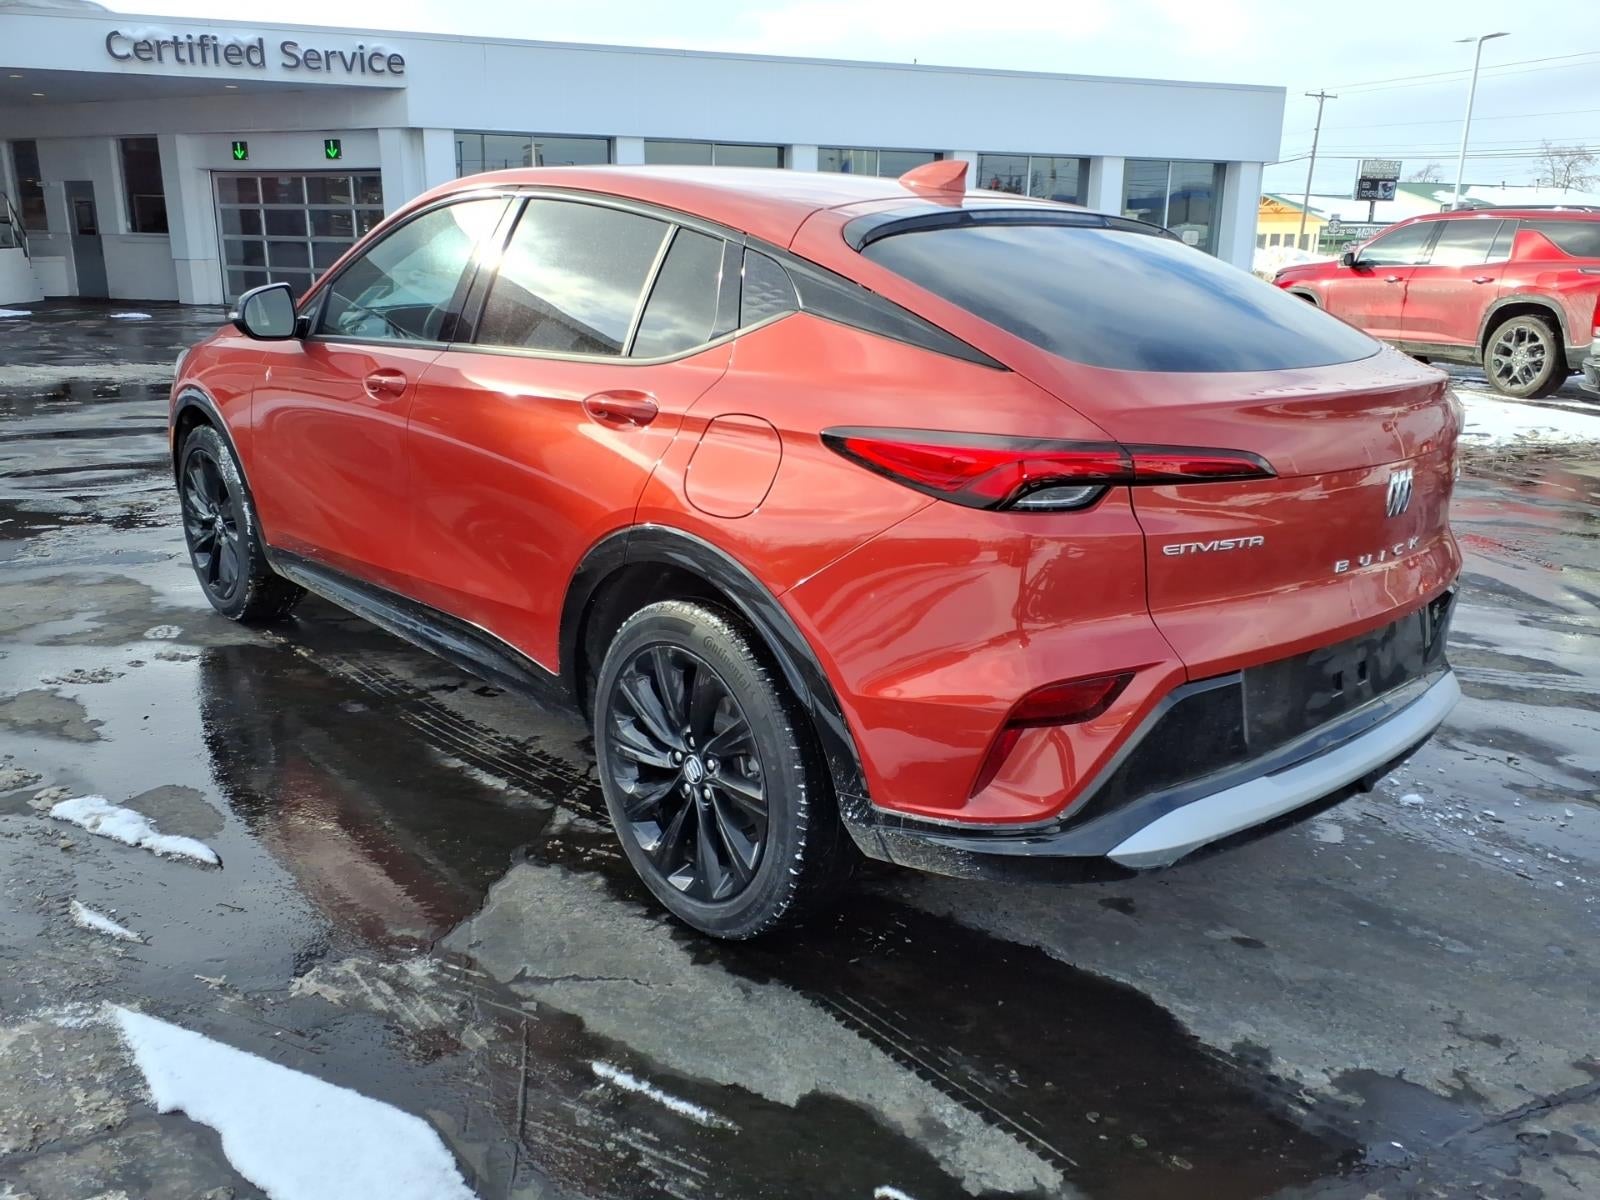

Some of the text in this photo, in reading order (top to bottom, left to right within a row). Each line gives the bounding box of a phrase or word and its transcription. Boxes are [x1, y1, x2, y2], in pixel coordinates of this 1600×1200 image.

[105, 30, 406, 75] Certified Service
[1162, 535, 1265, 556] ENVISTA
[1334, 536, 1420, 573] BUICK
[703, 636, 751, 690] Continental
